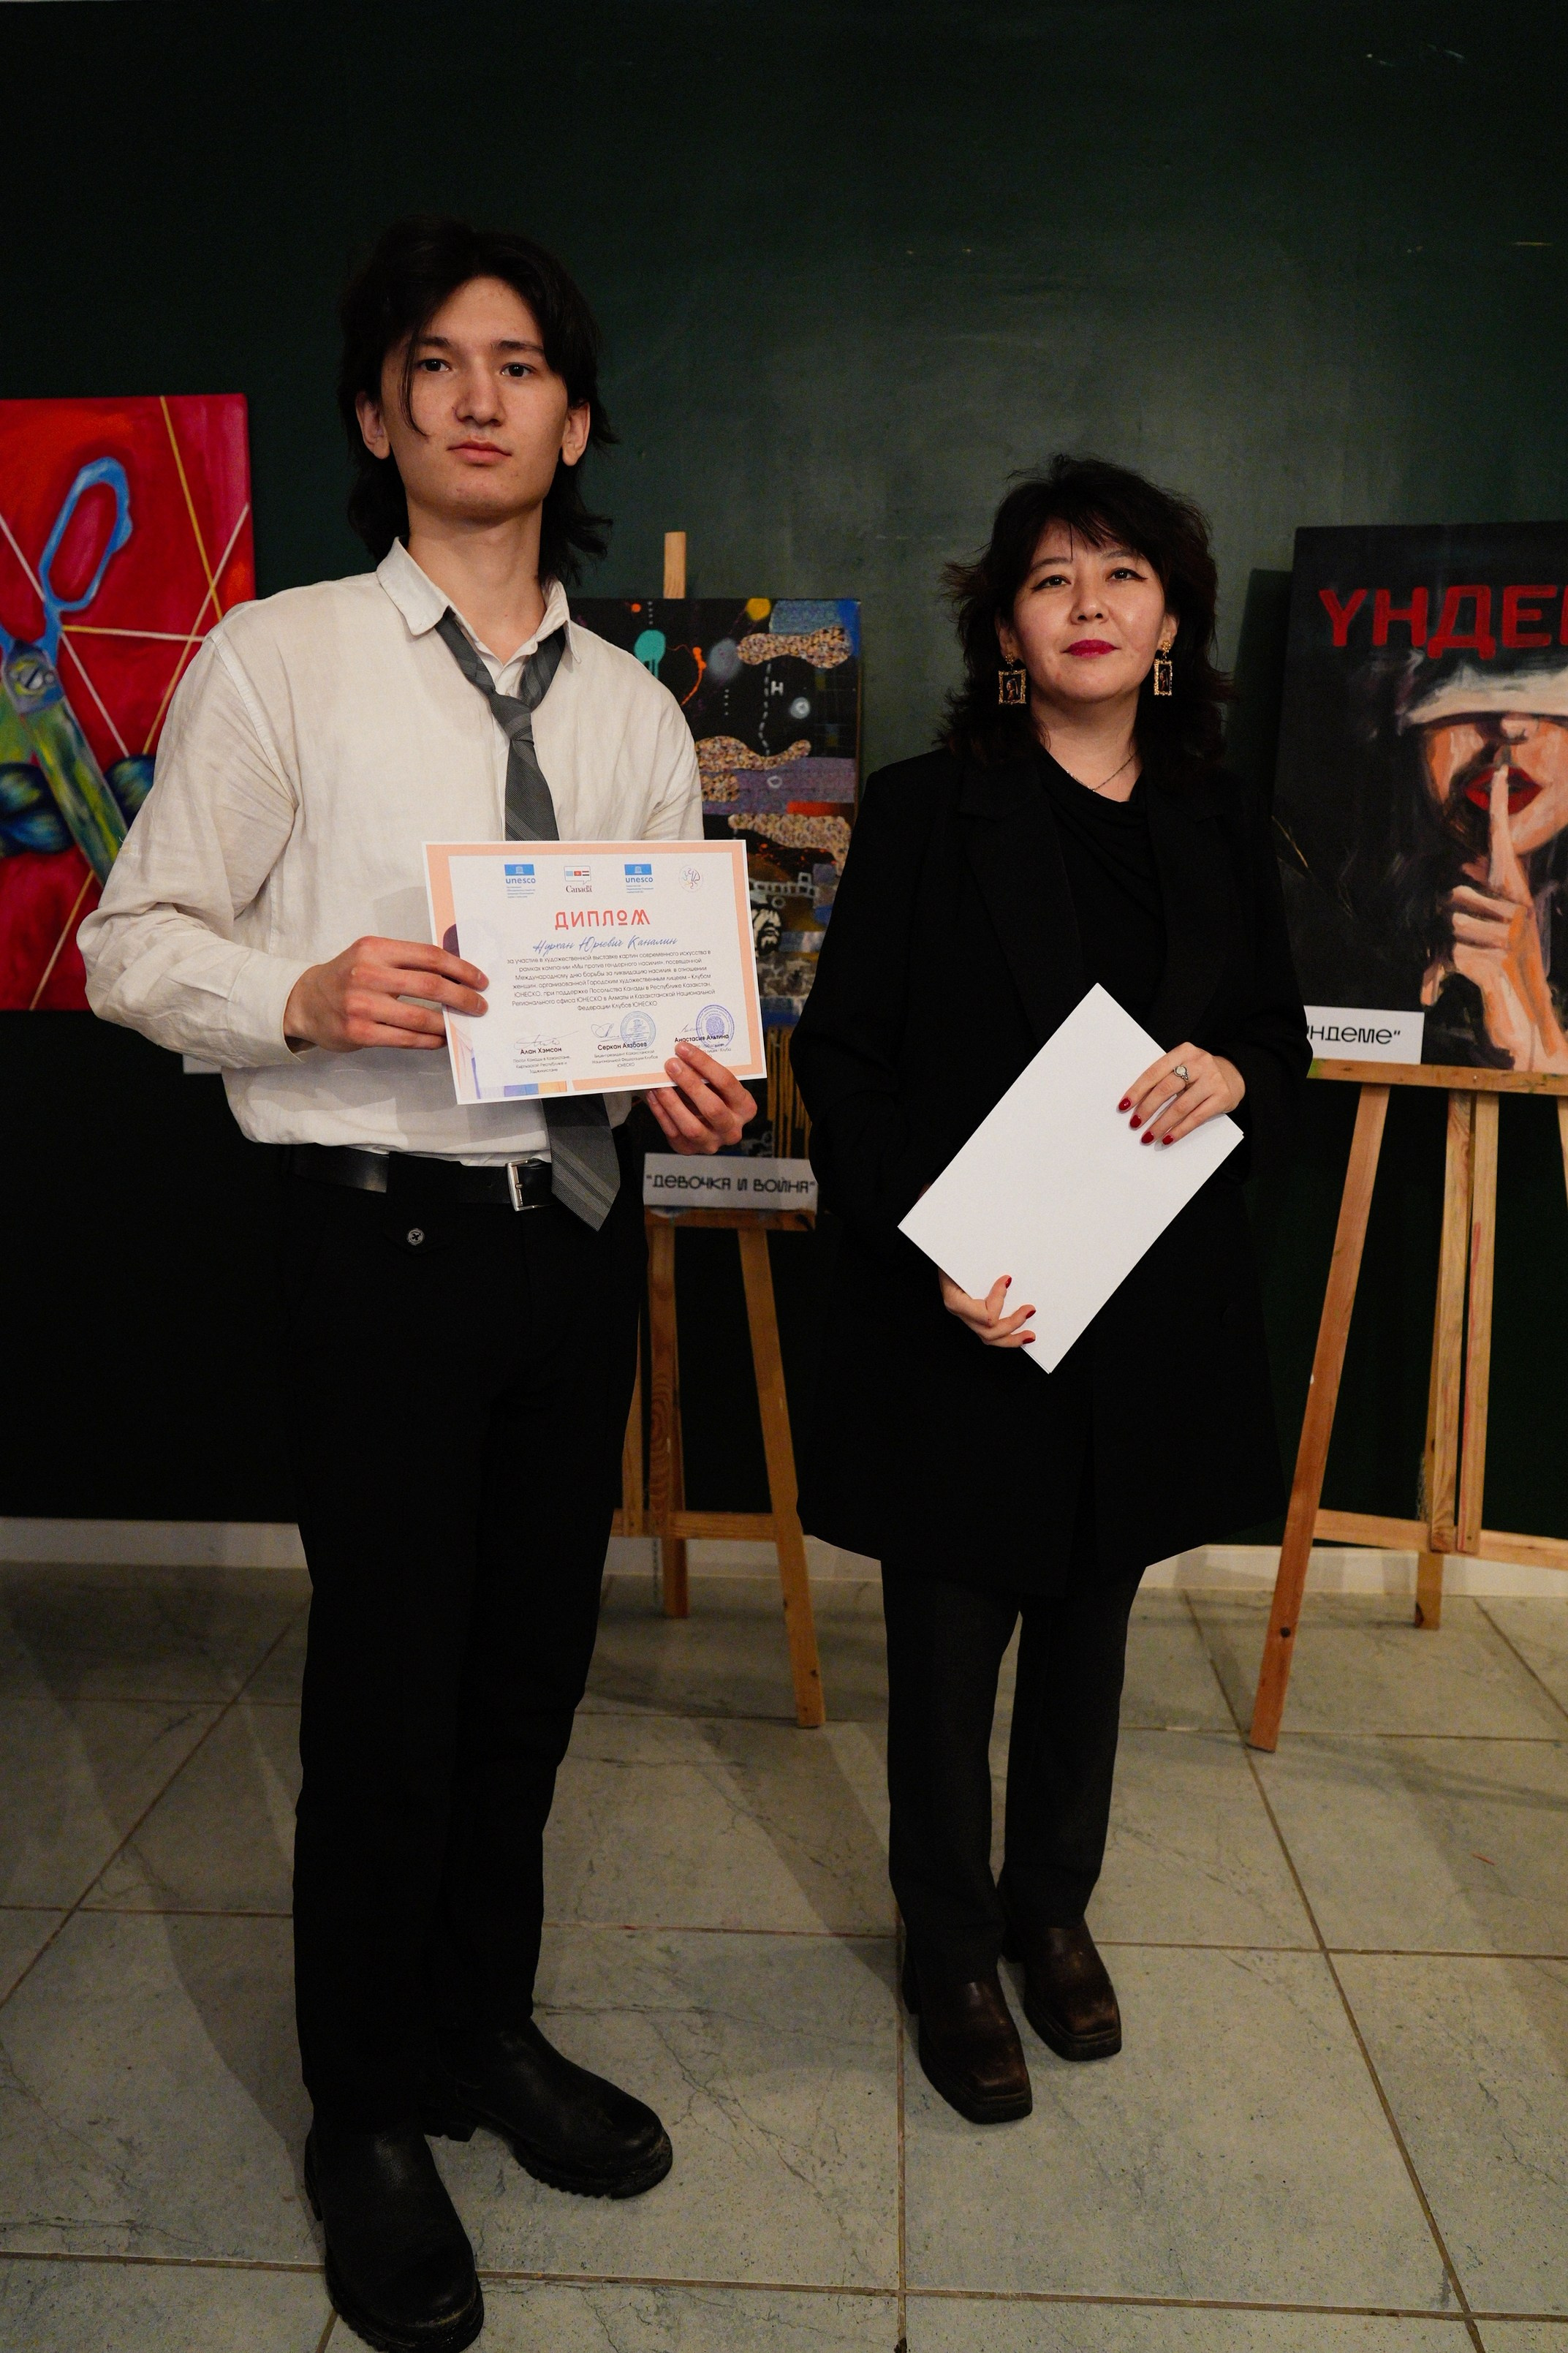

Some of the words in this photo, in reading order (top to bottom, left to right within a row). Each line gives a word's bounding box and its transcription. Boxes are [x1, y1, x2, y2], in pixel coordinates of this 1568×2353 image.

[1318, 584, 1568, 660] ҮНДЕ
[566, 885, 592, 893] Canada
[555, 910, 650, 929] ДИПЛОМ
[539, 980, 586, 988] организованной
[1307, 1025, 1401, 1044] ндеме"
